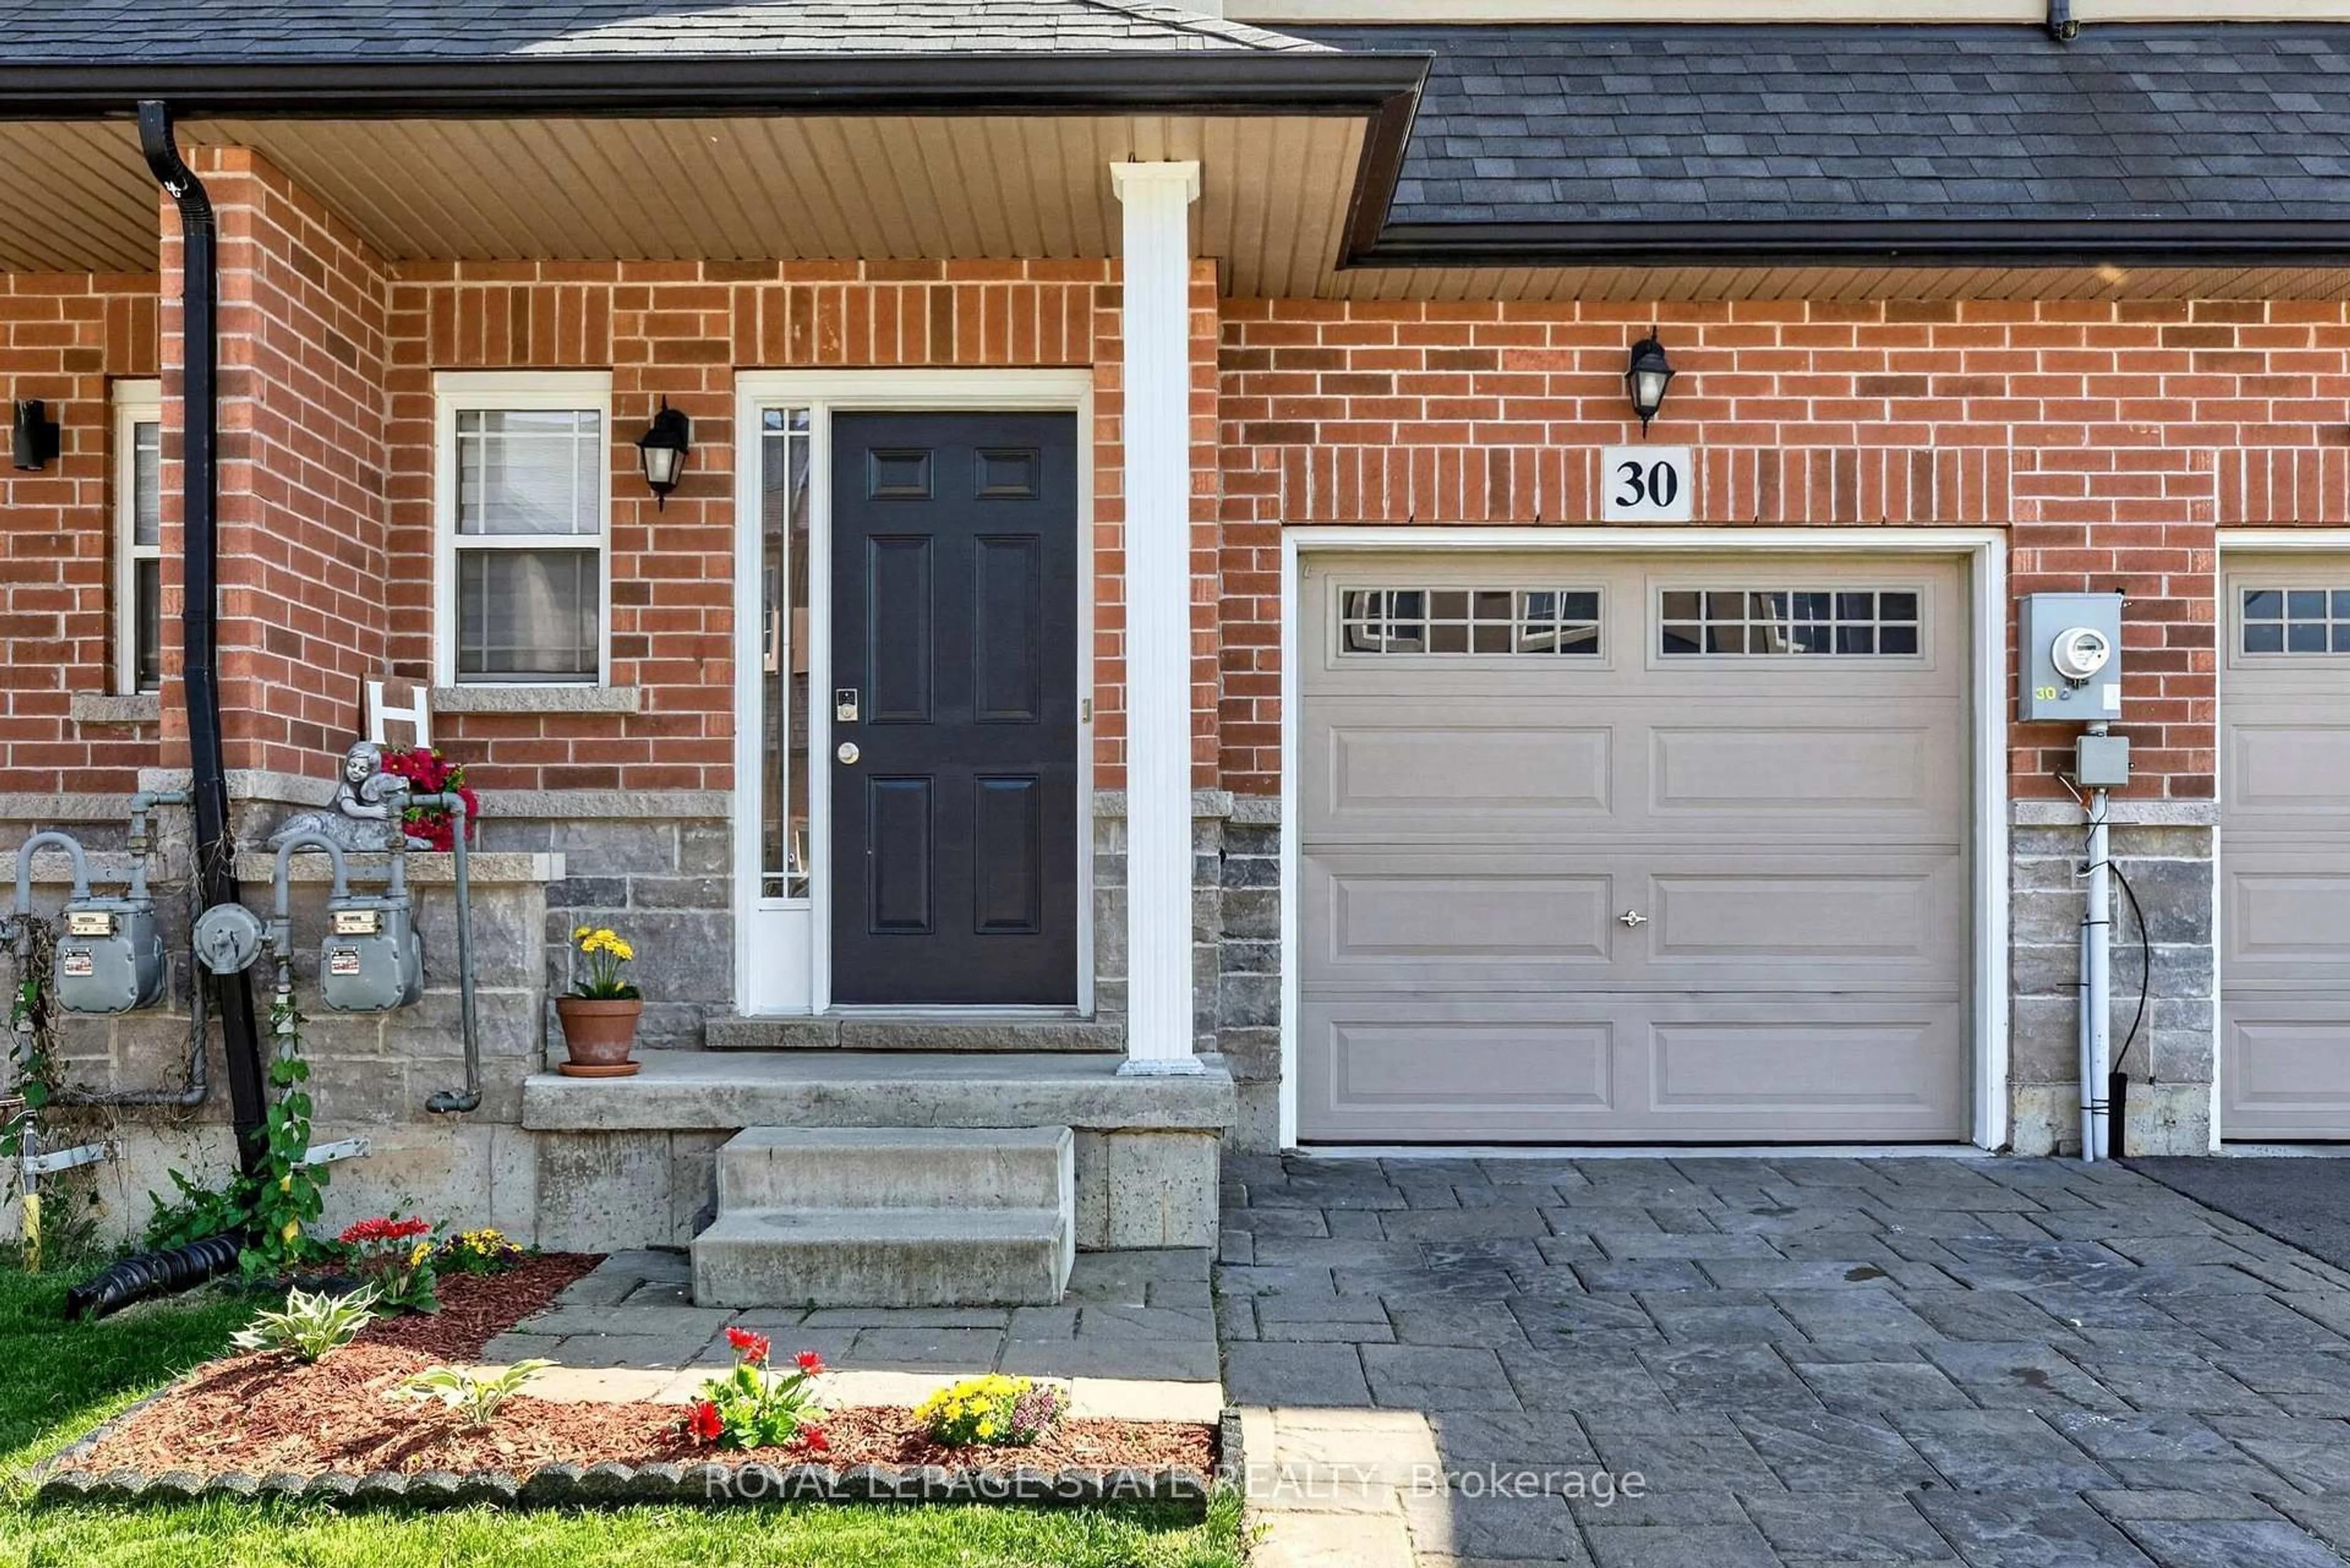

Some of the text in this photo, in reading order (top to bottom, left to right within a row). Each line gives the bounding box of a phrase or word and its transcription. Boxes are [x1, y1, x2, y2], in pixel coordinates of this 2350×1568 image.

[1616, 461, 1677, 507] 30
[368, 682, 431, 749] H
[2037, 687, 2056, 700] 30
